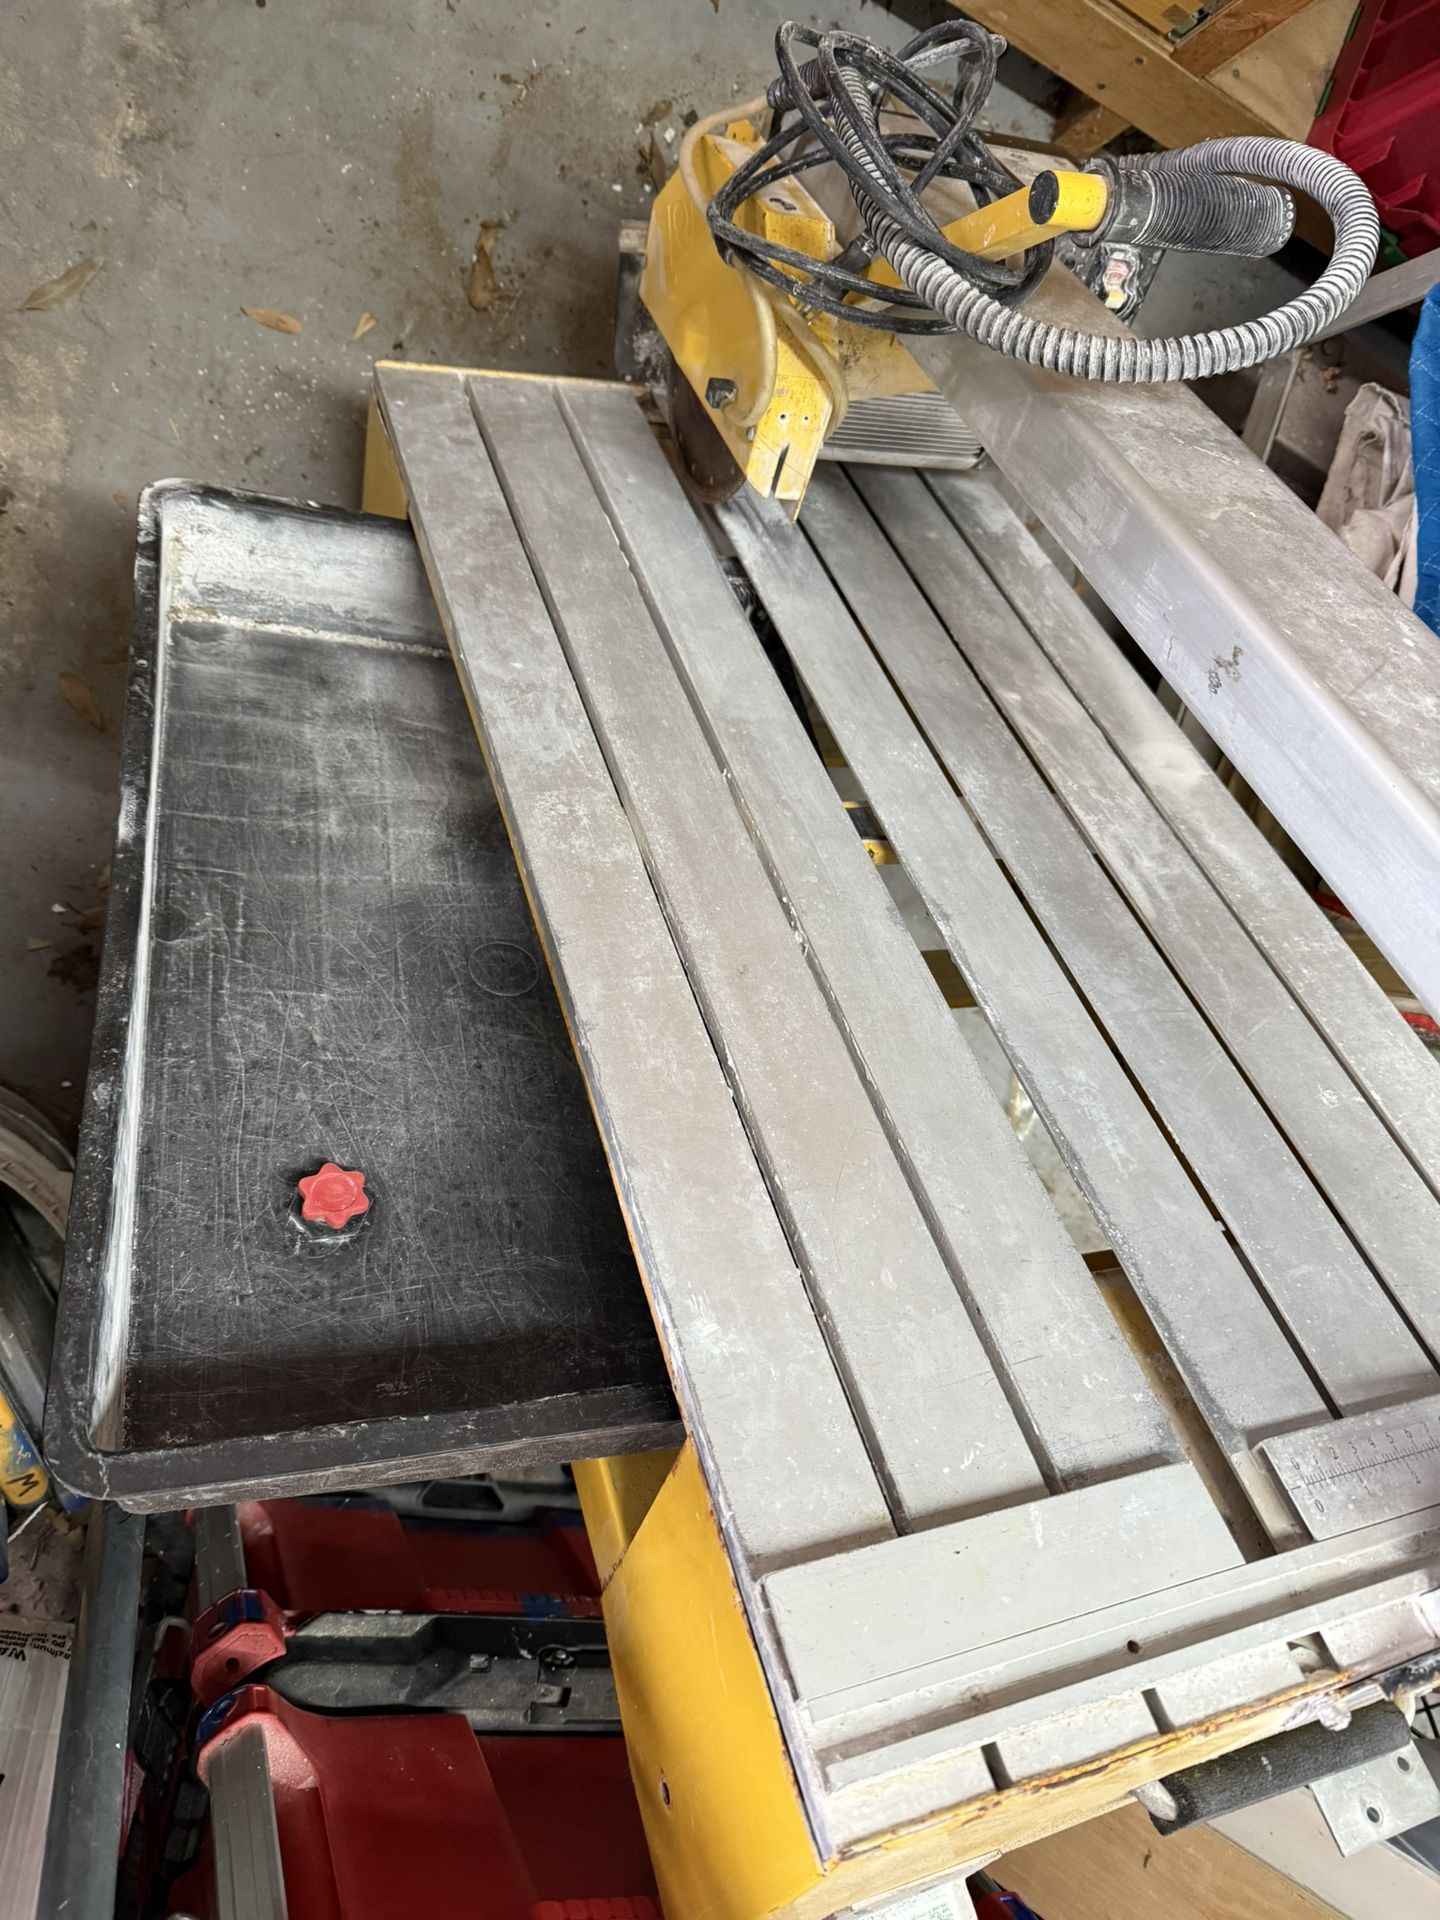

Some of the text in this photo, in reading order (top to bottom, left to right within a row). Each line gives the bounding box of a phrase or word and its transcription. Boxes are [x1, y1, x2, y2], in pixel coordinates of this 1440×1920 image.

[1290, 1457, 1300, 1471] 0
[1328, 1446, 1339, 1460] 2
[1347, 1440, 1358, 1455] 3
[1367, 1436, 1377, 1449] 4
[1385, 1431, 1395, 1445] 5
[6, 1471, 40, 1498] M
[1314, 1499, 1325, 1513] 0
